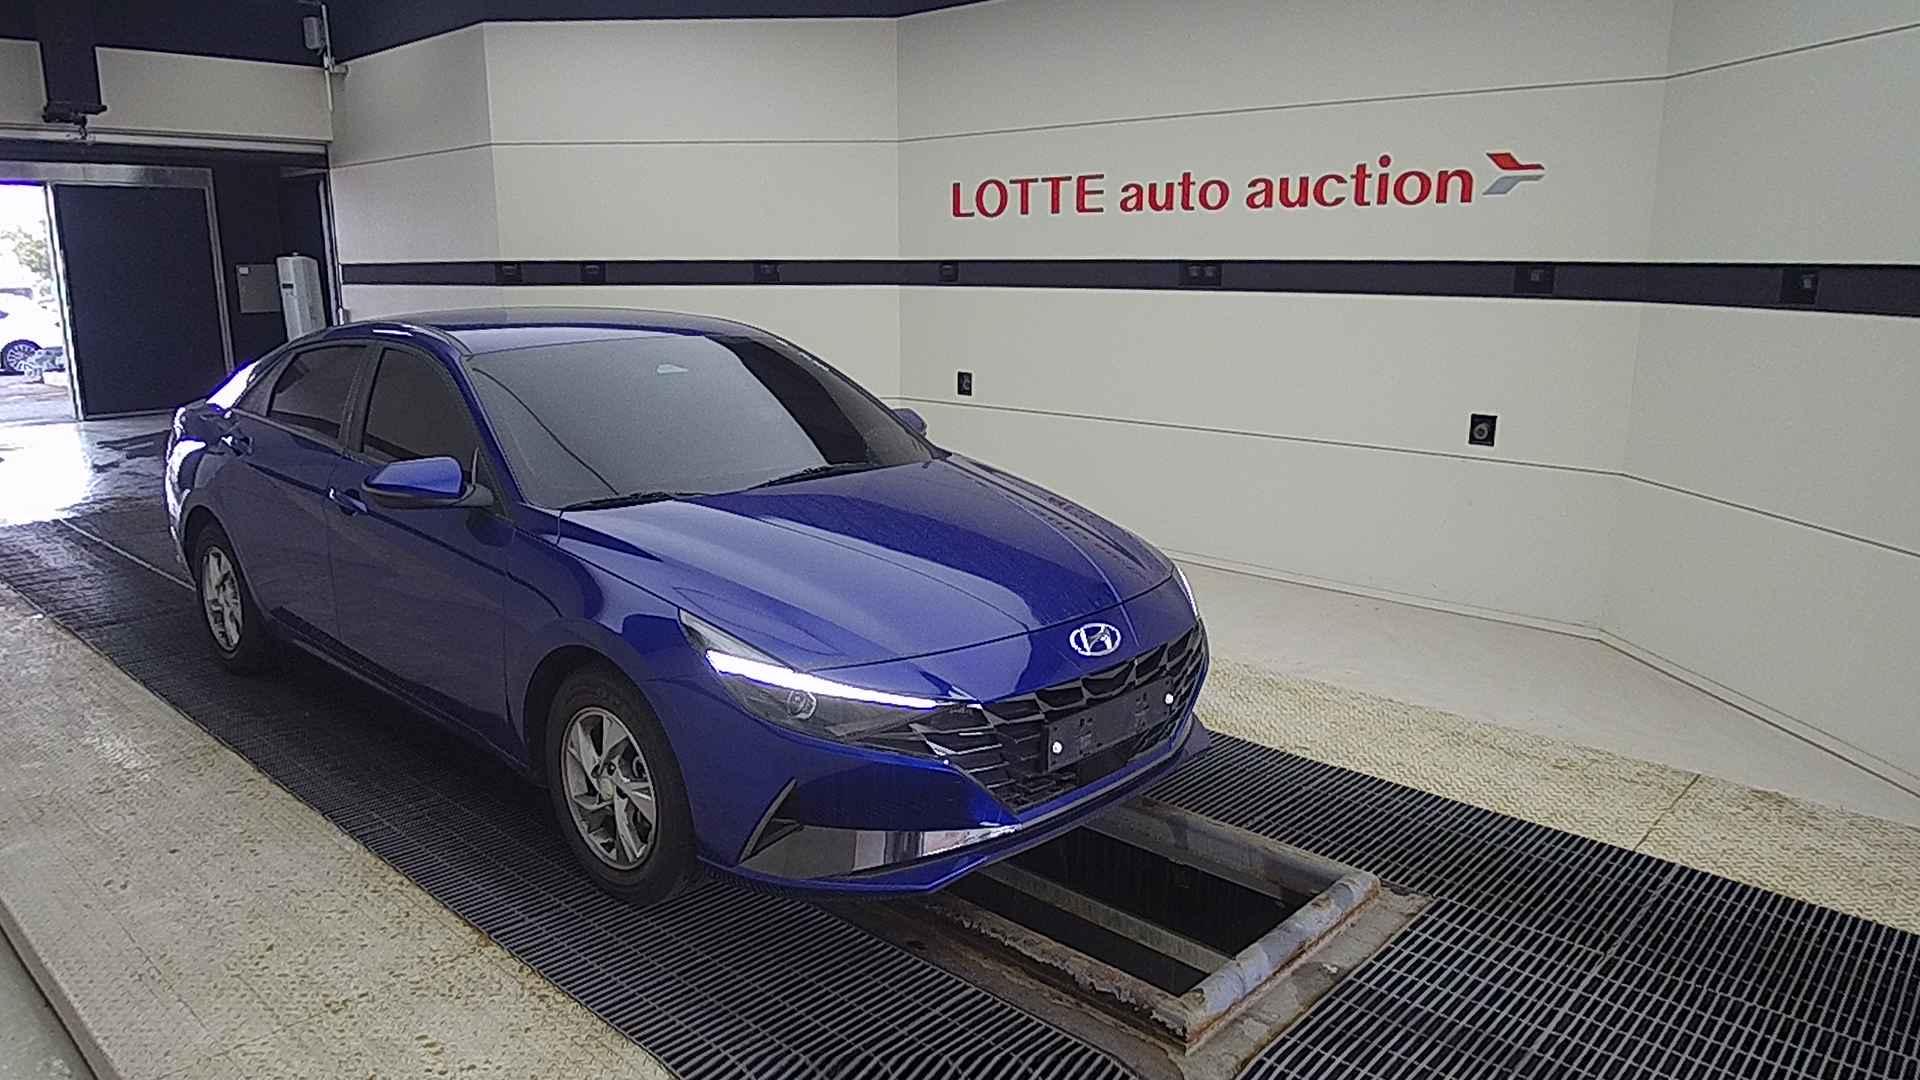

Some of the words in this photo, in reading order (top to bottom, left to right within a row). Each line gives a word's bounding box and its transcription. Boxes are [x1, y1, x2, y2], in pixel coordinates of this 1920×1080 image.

[952, 174, 1105, 218] LOTTE
[1120, 172, 1229, 213] auto
[1246, 155, 1473, 209] auction
